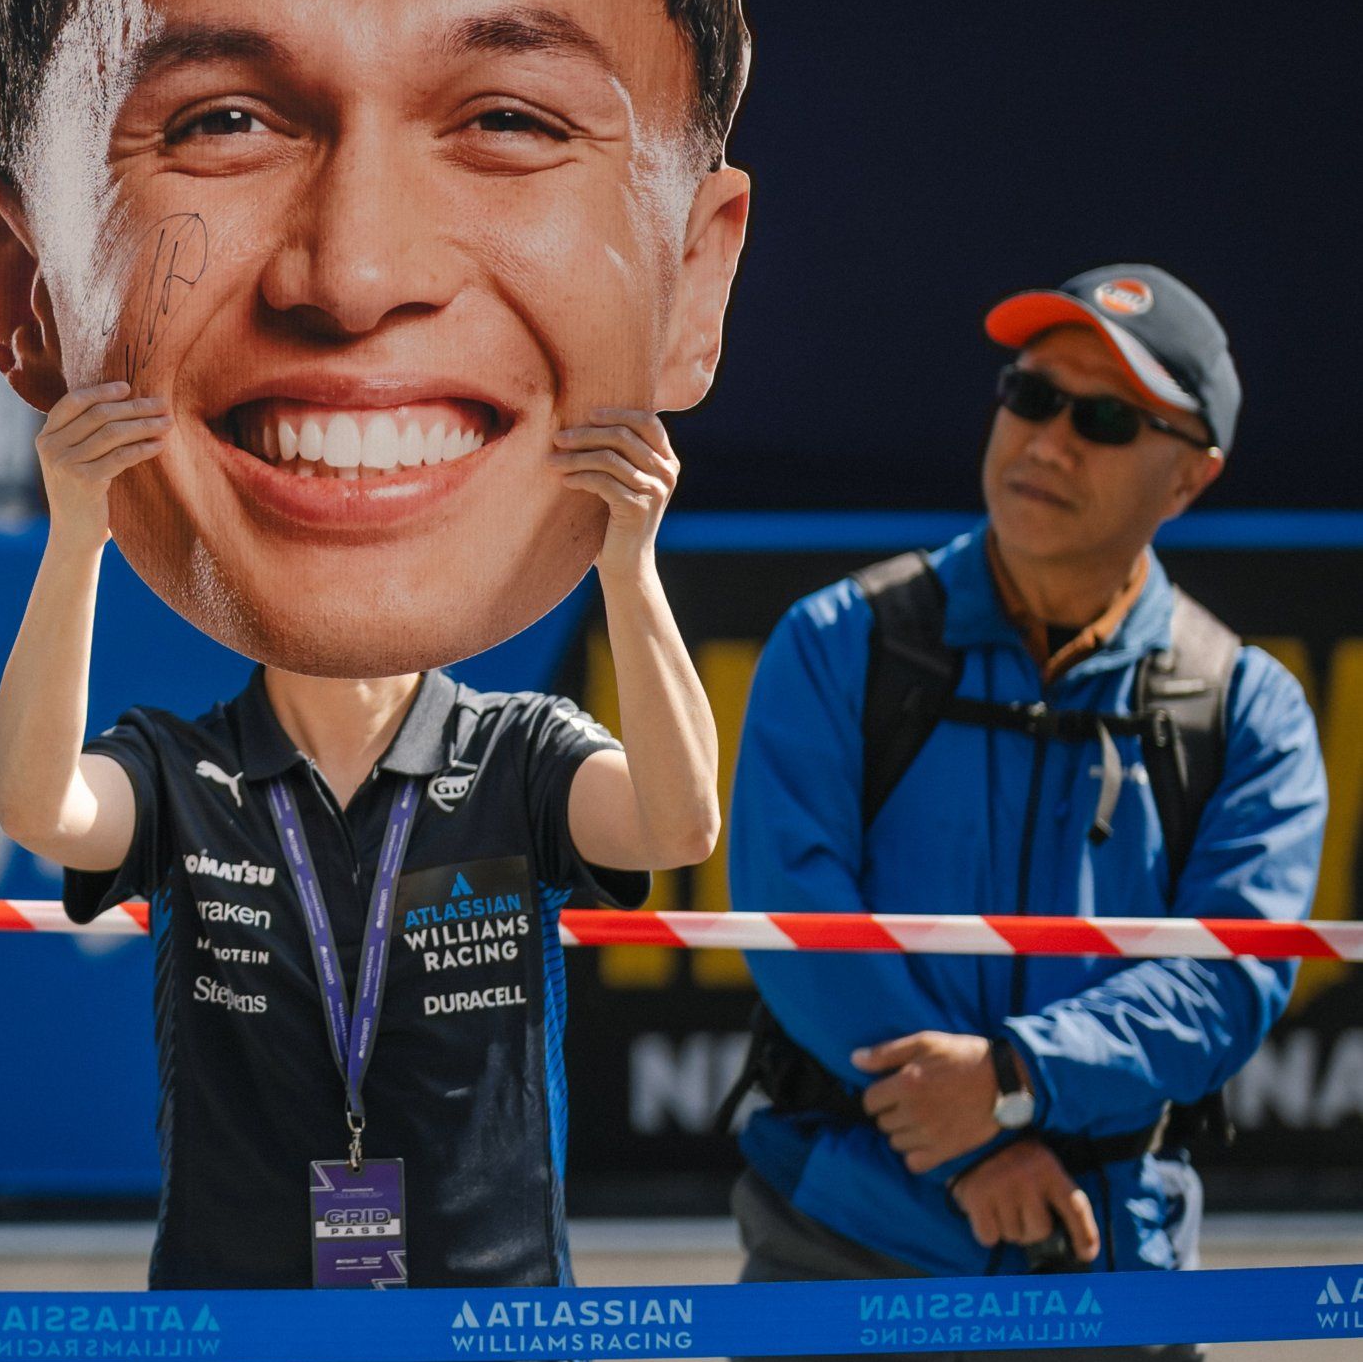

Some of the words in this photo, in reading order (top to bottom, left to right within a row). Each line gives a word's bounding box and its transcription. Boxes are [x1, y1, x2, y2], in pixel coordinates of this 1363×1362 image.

[183, 854, 276, 886] OMATSU
[404, 894, 522, 928] ATLASSIAN
[403, 915, 529, 951] WILLIAMS
[423, 940, 518, 972] RACING
[423, 985, 527, 1015] DURACELL
[325, 1208, 391, 1227] GRID
[330, 1227, 385, 1235] PASS
[487, 1299, 692, 1327] ATLASSIAN
